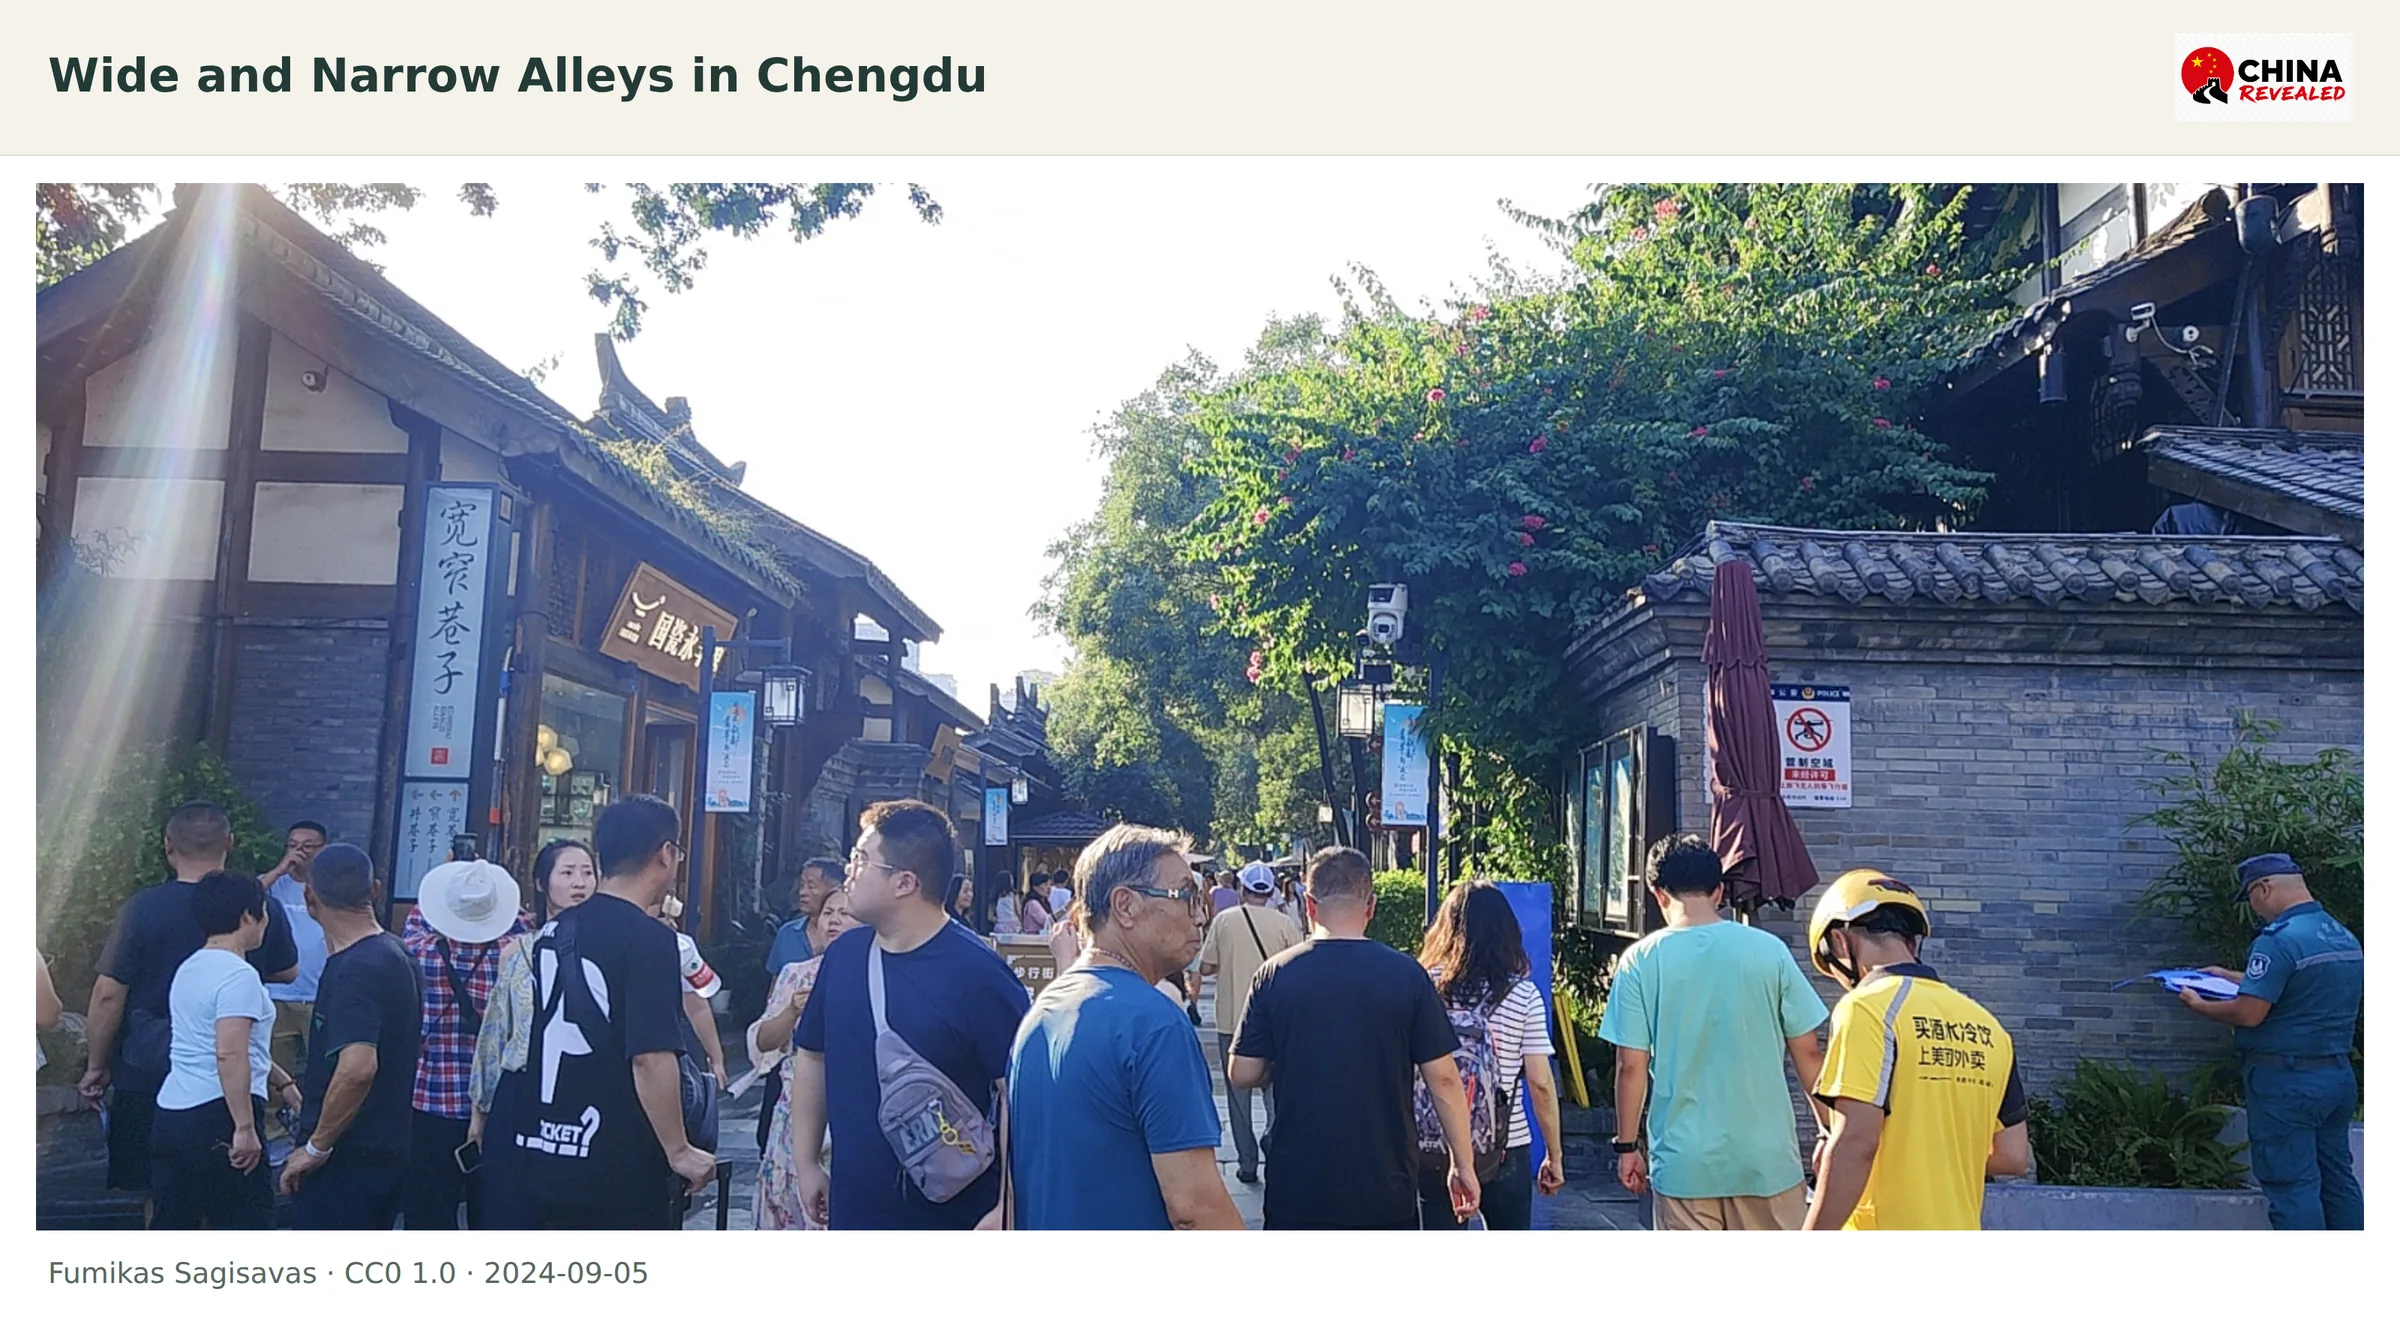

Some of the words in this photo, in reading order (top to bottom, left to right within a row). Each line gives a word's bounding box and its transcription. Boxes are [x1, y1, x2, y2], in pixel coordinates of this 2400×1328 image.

[429, 500, 478, 695] 宽窄巷子
[1817, 690, 1840, 698] POLICE
[1912, 1016, 1994, 1048] 买酒水冷饮
